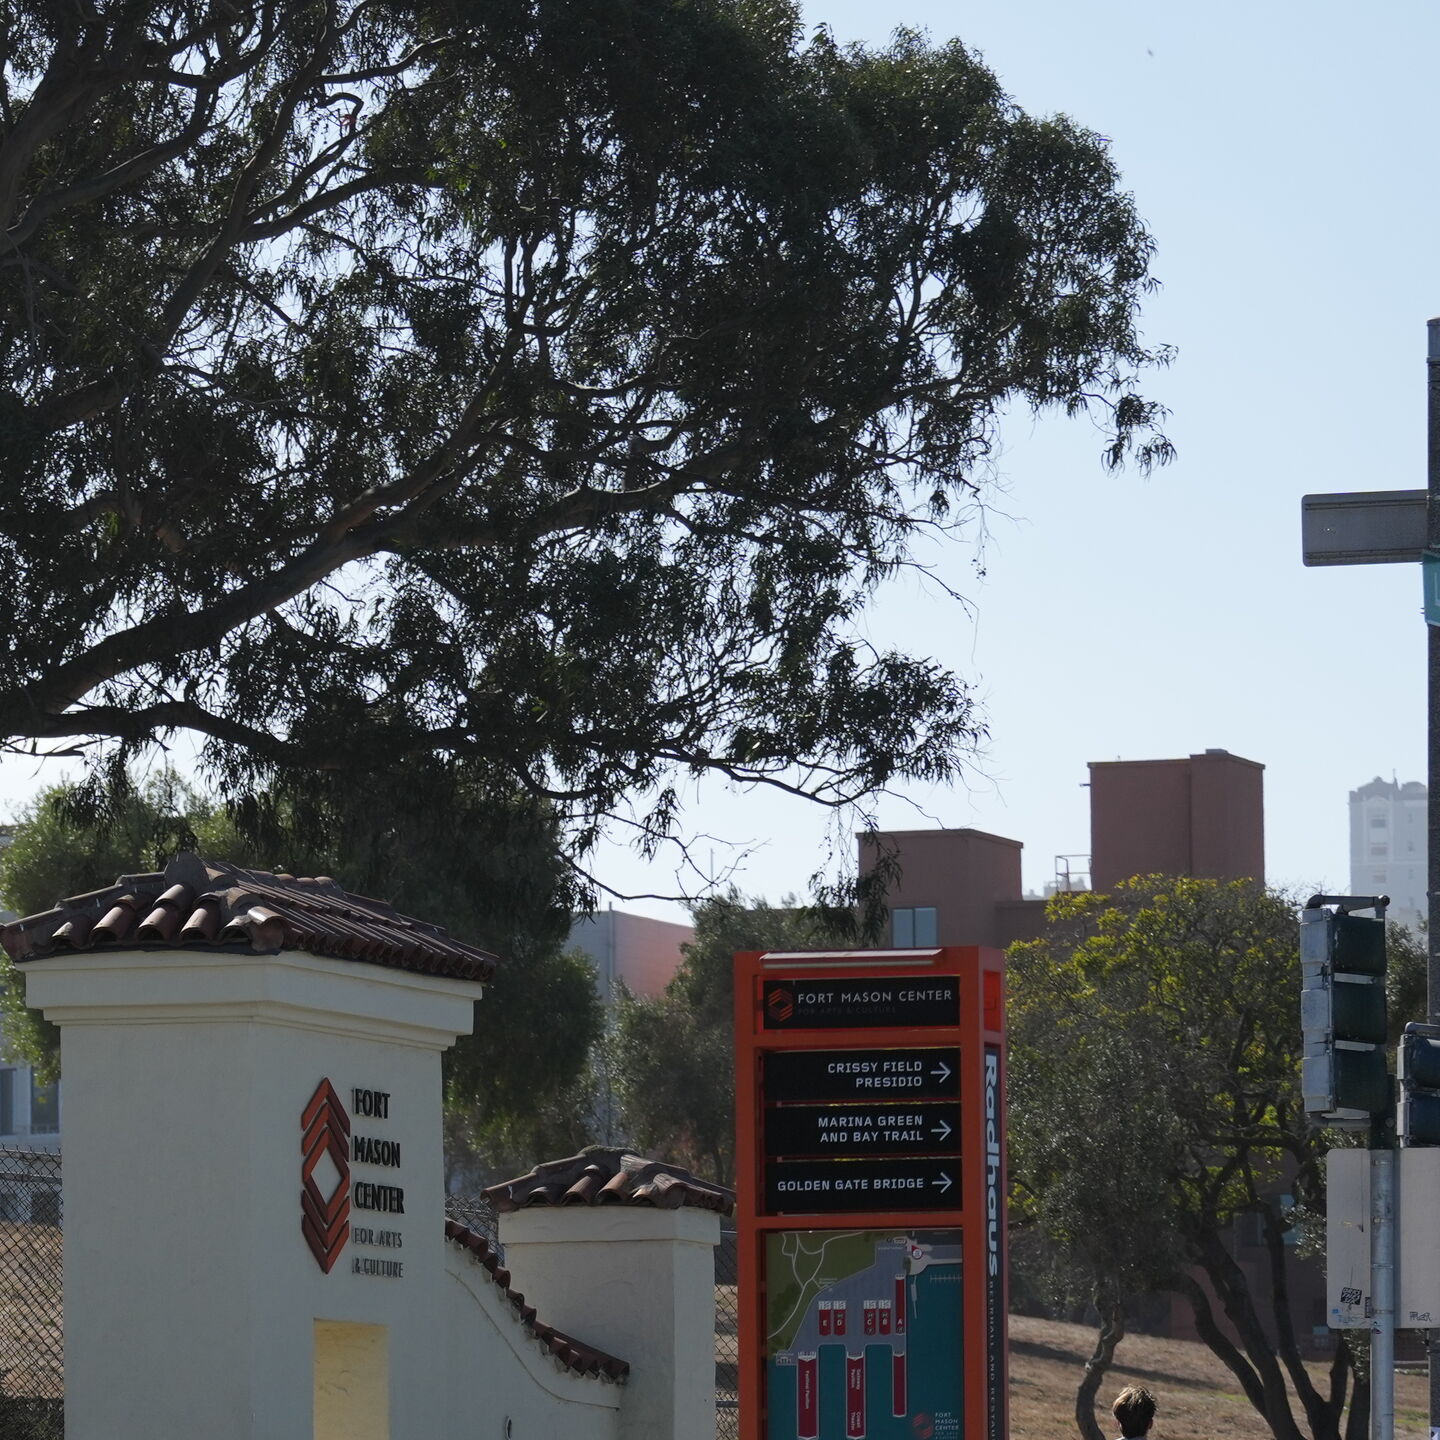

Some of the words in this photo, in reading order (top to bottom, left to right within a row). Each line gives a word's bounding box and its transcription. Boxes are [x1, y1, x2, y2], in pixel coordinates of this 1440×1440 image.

[798, 993, 834, 1004] FORT
[841, 991, 892, 1003] MASON
[898, 990, 952, 1002] CENTER
[827, 1062, 877, 1074] CRISSY
[883, 1061, 922, 1073] FIELD
[855, 1077, 922, 1088] PRESIDIO
[354, 1088, 390, 1119] FORT
[818, 1117, 872, 1128] MARINA
[877, 1115, 923, 1127] GREEN
[820, 1132, 848, 1143] AND
[853, 1131, 878, 1142] BAY
[884, 1130, 924, 1142] TRAIL
[353, 1136, 401, 1168] MASON
[985, 1054, 1000, 1278] Radhaus
[777, 1180, 830, 1191] GOLDEN
[834, 1179, 869, 1191] GATE
[873, 1178, 924, 1190] BRIDGE
[354, 1181, 405, 1214] CENTER
[353, 1228, 374, 1245] FOR
[379, 1231, 403, 1248] ARTS
[354, 1258, 361, 1273] &
[363, 1258, 404, 1278] CULTURE
